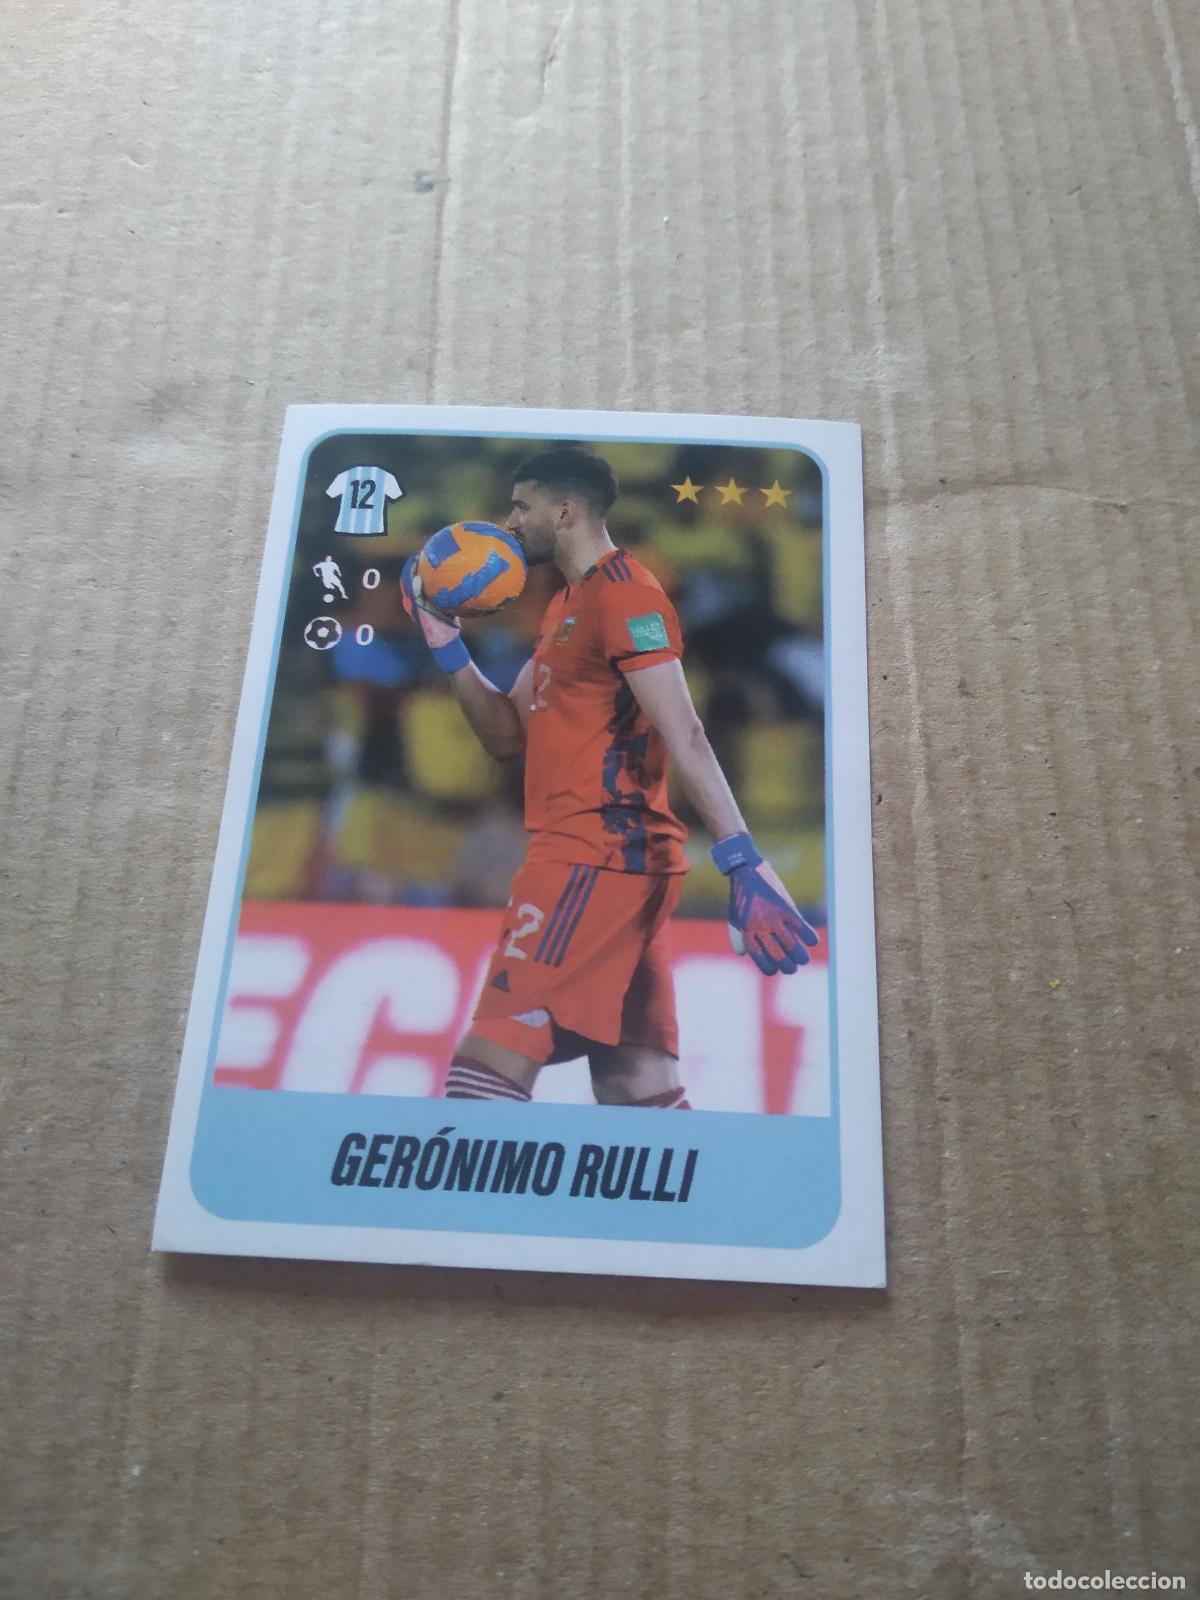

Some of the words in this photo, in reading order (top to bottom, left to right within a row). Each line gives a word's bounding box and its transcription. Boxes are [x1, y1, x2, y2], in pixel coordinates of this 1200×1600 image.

[350, 479, 377, 510] 12
[362, 568, 381, 589] 0
[355, 623, 374, 646] 0
[504, 898, 545, 960] 2
[330, 1126, 566, 1197] GERÓNIMO
[569, 1144, 699, 1203] RULLI
